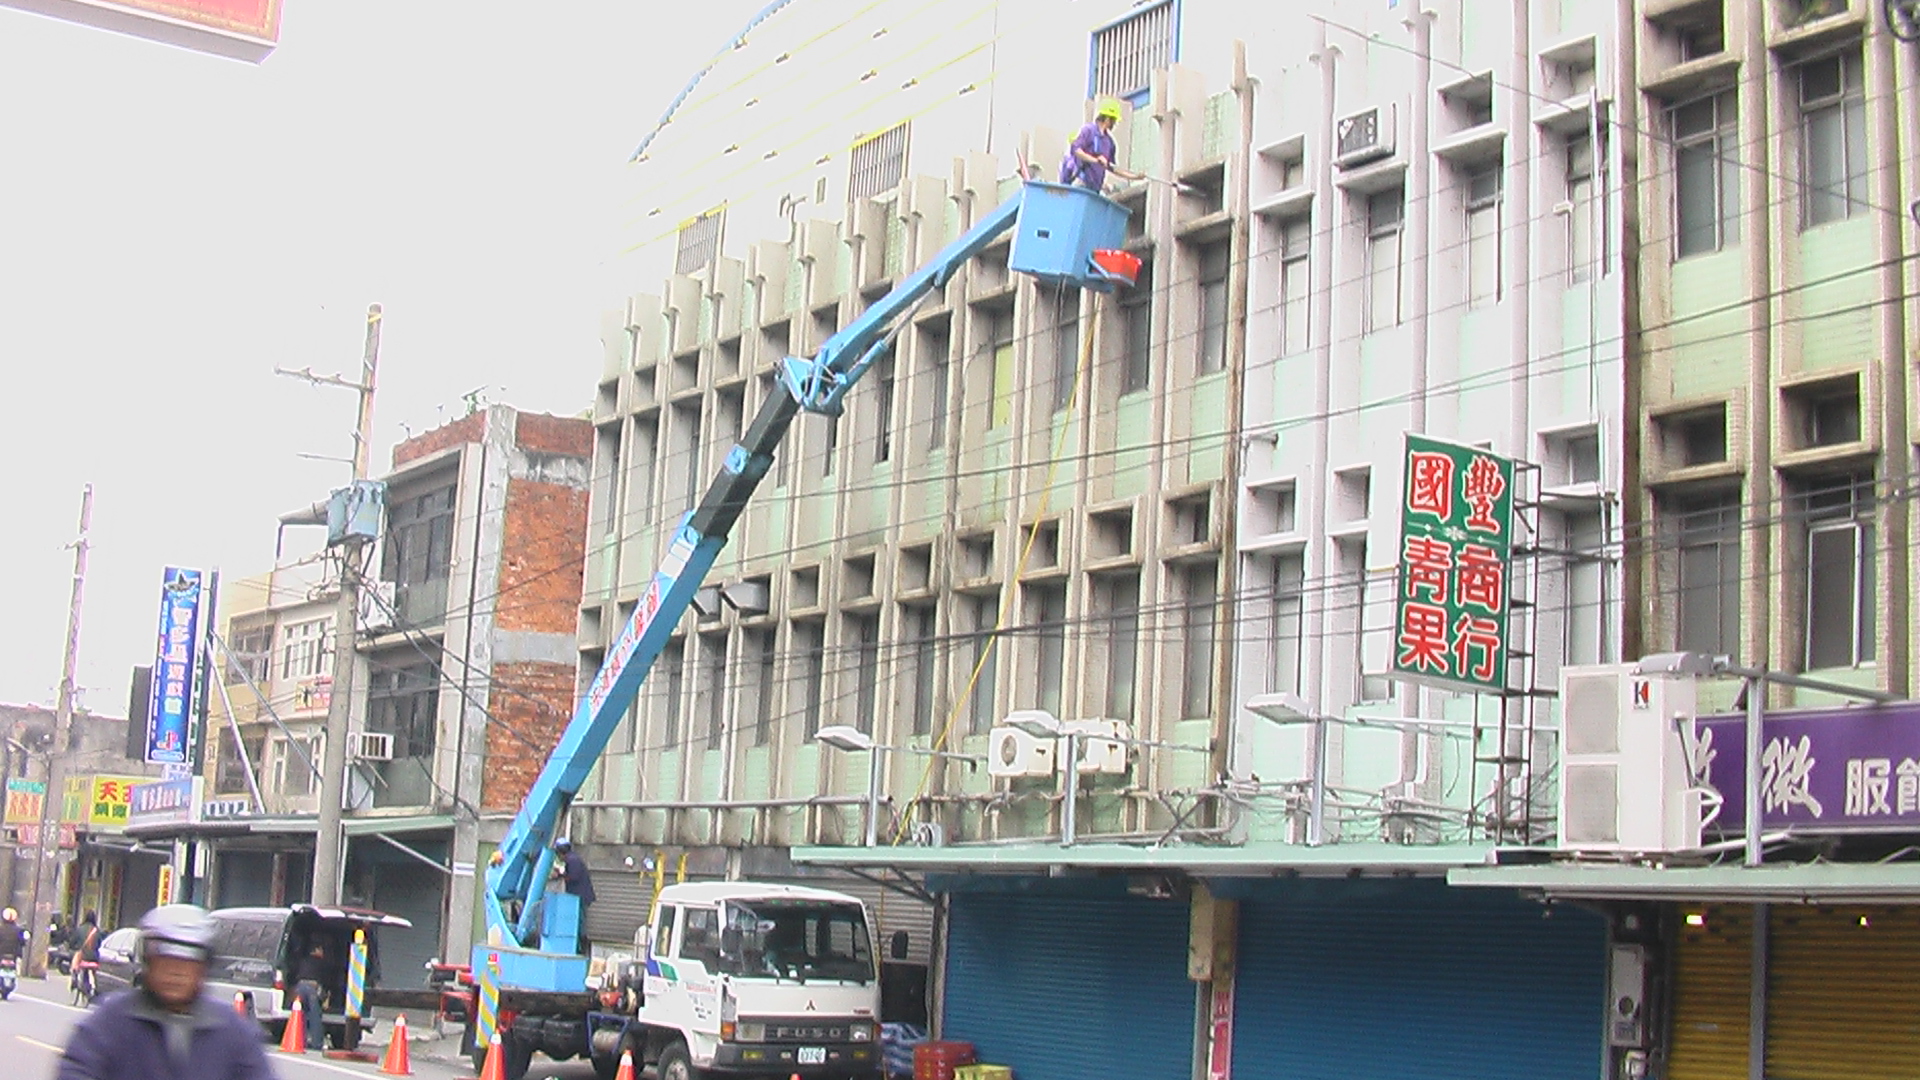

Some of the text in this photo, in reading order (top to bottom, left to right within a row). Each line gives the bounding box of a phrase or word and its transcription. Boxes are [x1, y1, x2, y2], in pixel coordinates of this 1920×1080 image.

[1408, 451, 1505, 532] 國豐
[1399, 535, 1451, 674] 青果
[1452, 544, 1503, 681] 商行
[776, 1026, 841, 1039] FUSO
